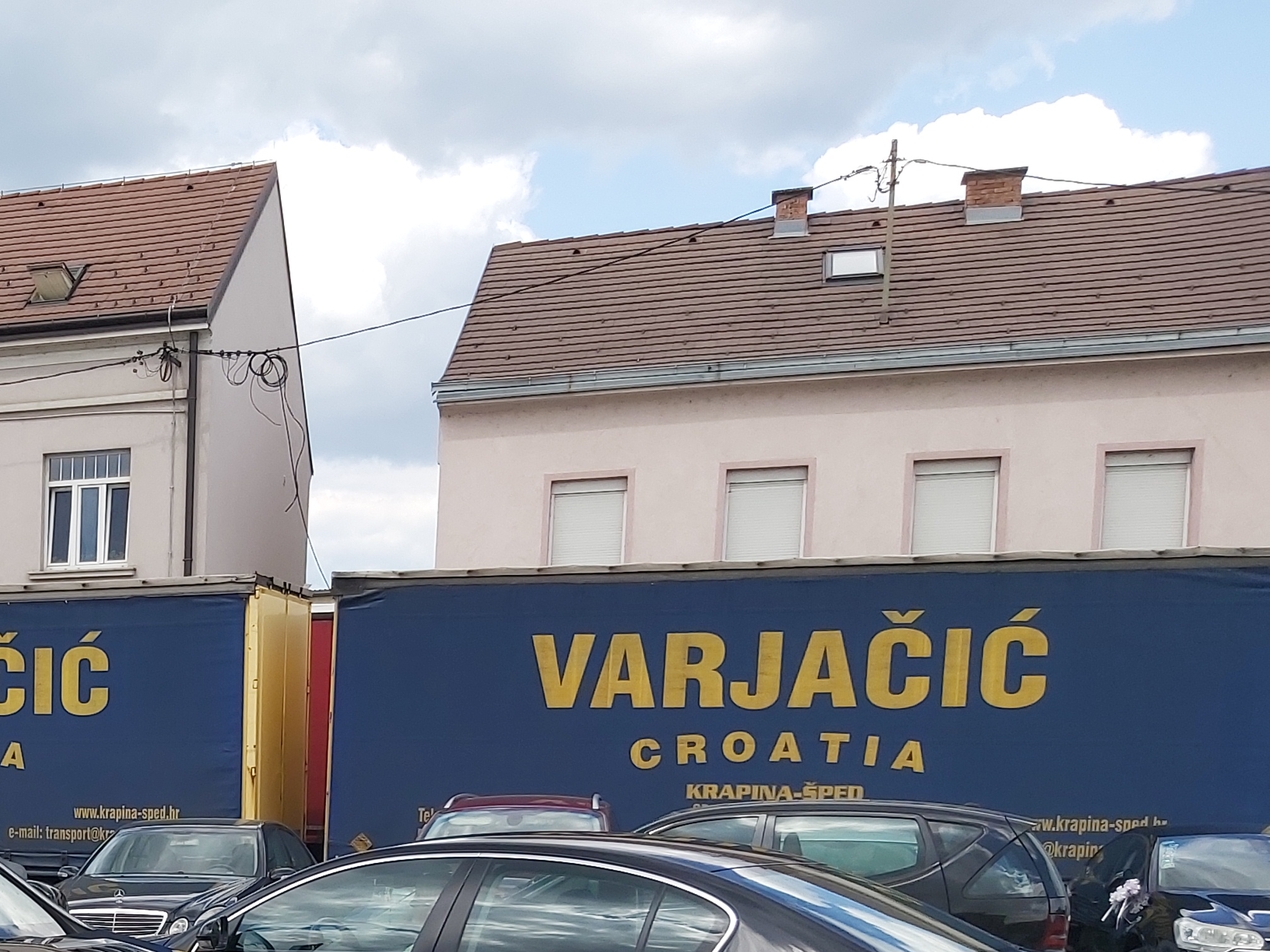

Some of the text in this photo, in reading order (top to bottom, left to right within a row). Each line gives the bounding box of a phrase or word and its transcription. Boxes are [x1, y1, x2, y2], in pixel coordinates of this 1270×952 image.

[532, 608, 1049, 711] VARJAČIĆ
[630, 731, 926, 774] CROATIA
[686, 782, 865, 801] KRAPINA-ŠPED
[74, 805, 180, 822] www.krapina-sped.hr
[8, 825, 43, 839] e-mail:
